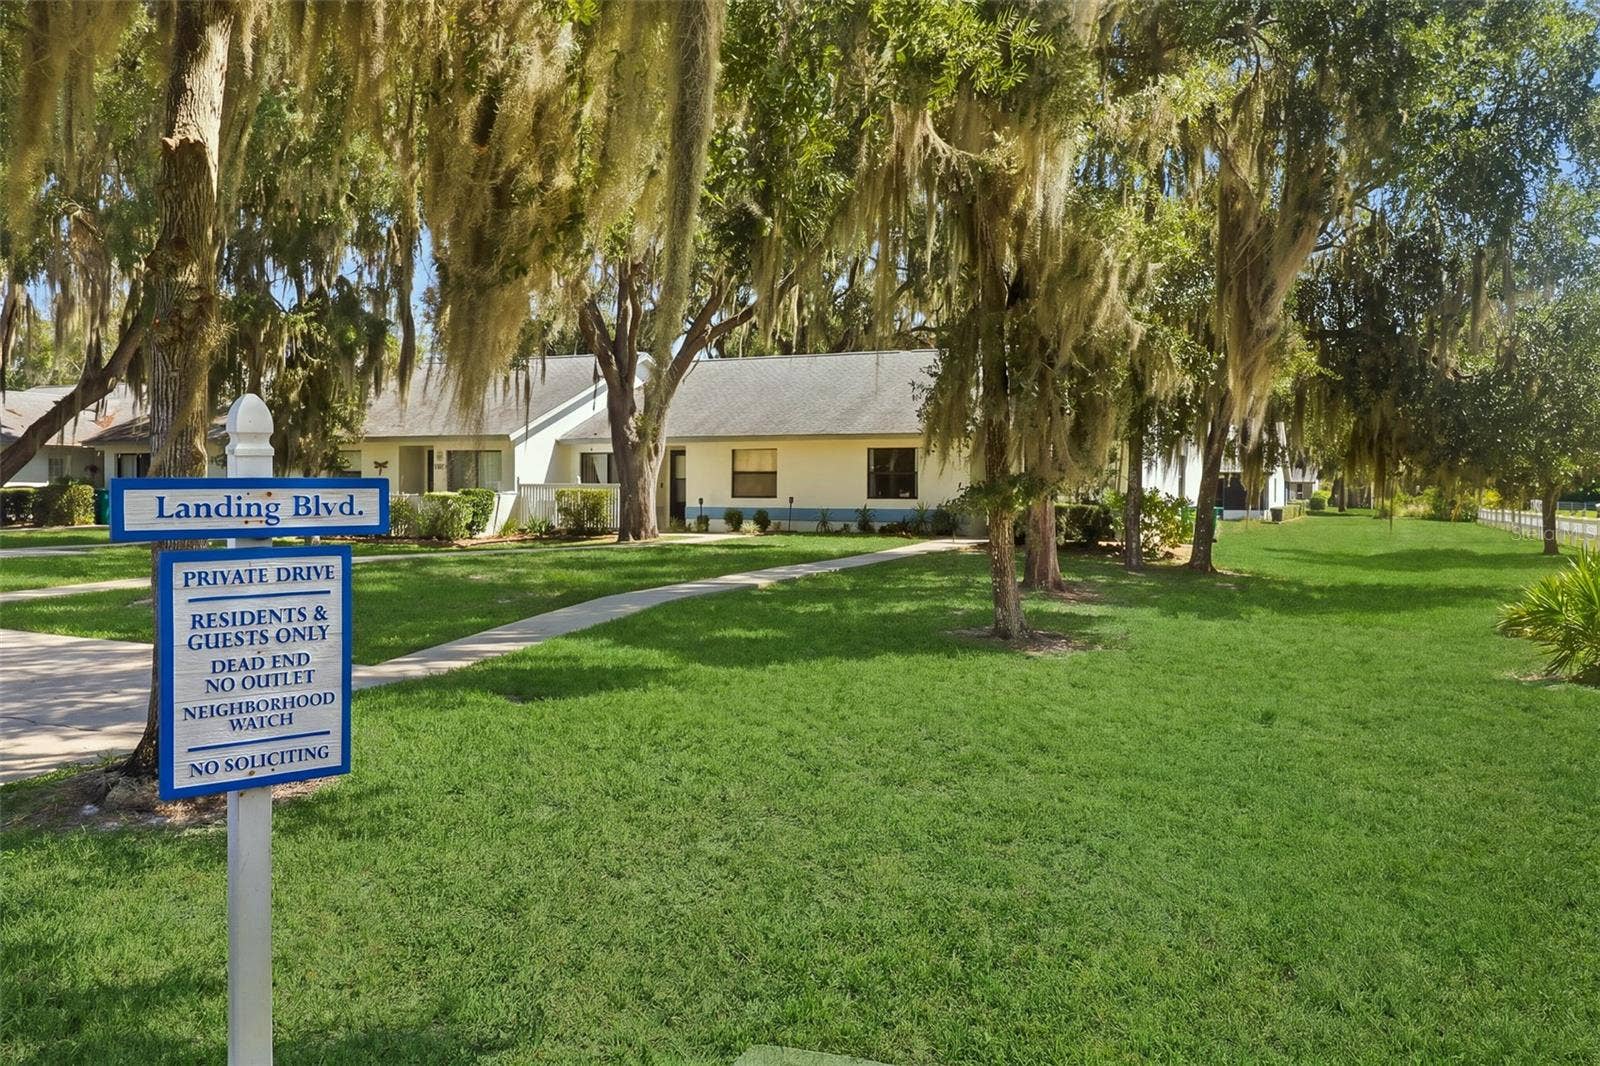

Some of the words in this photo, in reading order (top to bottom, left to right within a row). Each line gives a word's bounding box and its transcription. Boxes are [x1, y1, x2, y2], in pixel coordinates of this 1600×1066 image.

[156, 496, 280, 525] Landing
[293, 495, 363, 516] Blvd.
[183, 569, 268, 587] PRIVATE
[276, 565, 335, 581] DRIVE
[191, 607, 307, 629] RESIDENTS
[314, 605, 328, 621] &
[188, 629, 269, 650] GUESTS
[276, 625, 329, 643] ONLY
[212, 655, 264, 674] DEAD
[272, 653, 310, 668] END
[205, 679, 235, 693] NO
[241, 670, 315, 689] OUTLET
[183, 692, 335, 721] NEIGHBORHOOD
[229, 713, 293, 731] WATCH
[190, 761, 219, 777] NO
[225, 746, 329, 772] SOLICITING
